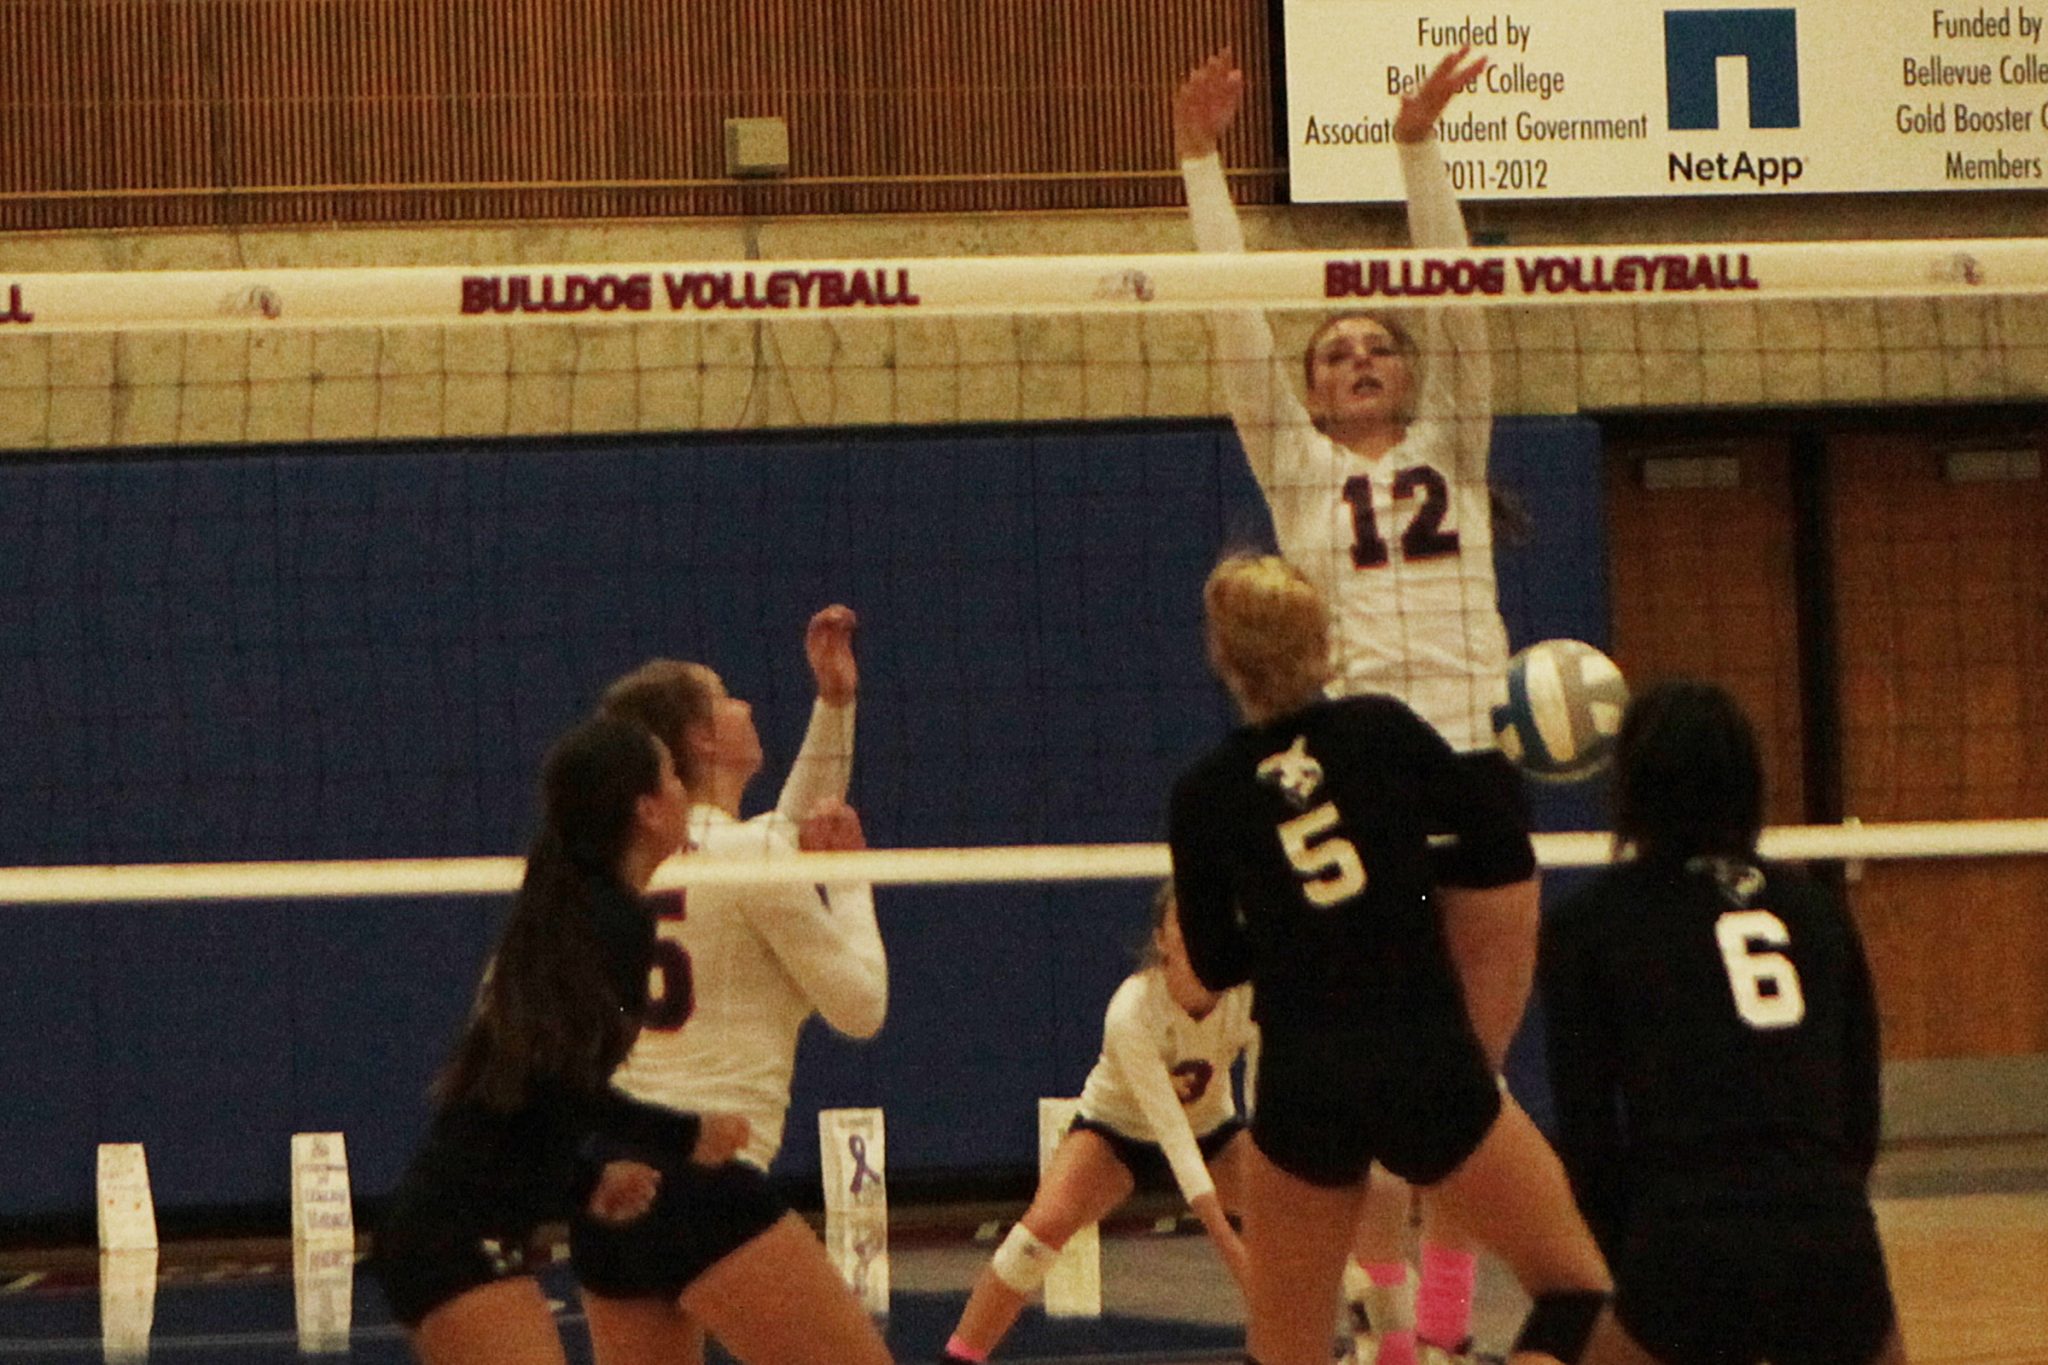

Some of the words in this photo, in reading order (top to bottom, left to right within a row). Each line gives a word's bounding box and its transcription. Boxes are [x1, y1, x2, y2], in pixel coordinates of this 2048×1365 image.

[1418, 15, 1497, 46] Funded
[1507, 15, 1531, 52] by
[1933, 8, 2010, 39] Funded
[2019, 6, 2042, 43] by
[1486, 62, 1565, 99] College
[1903, 55, 1992, 86] Bellevue
[1516, 112, 1648, 141] Government
[1896, 103, 1946, 133] Gold
[1954, 103, 2032, 133] Booster
[1668, 151, 1804, 185] NetApp
[1946, 149, 2042, 180] Members
[460, 273, 652, 314] BULLDOG
[663, 269, 920, 310] VOLLEYBALL
[1324, 258, 1505, 298] BULLDOG
[1515, 253, 1759, 294] VOLLEYBALL
[1341, 464, 1461, 571] 12
[1277, 801, 1367, 908] 5
[1715, 909, 1806, 1029] 6
